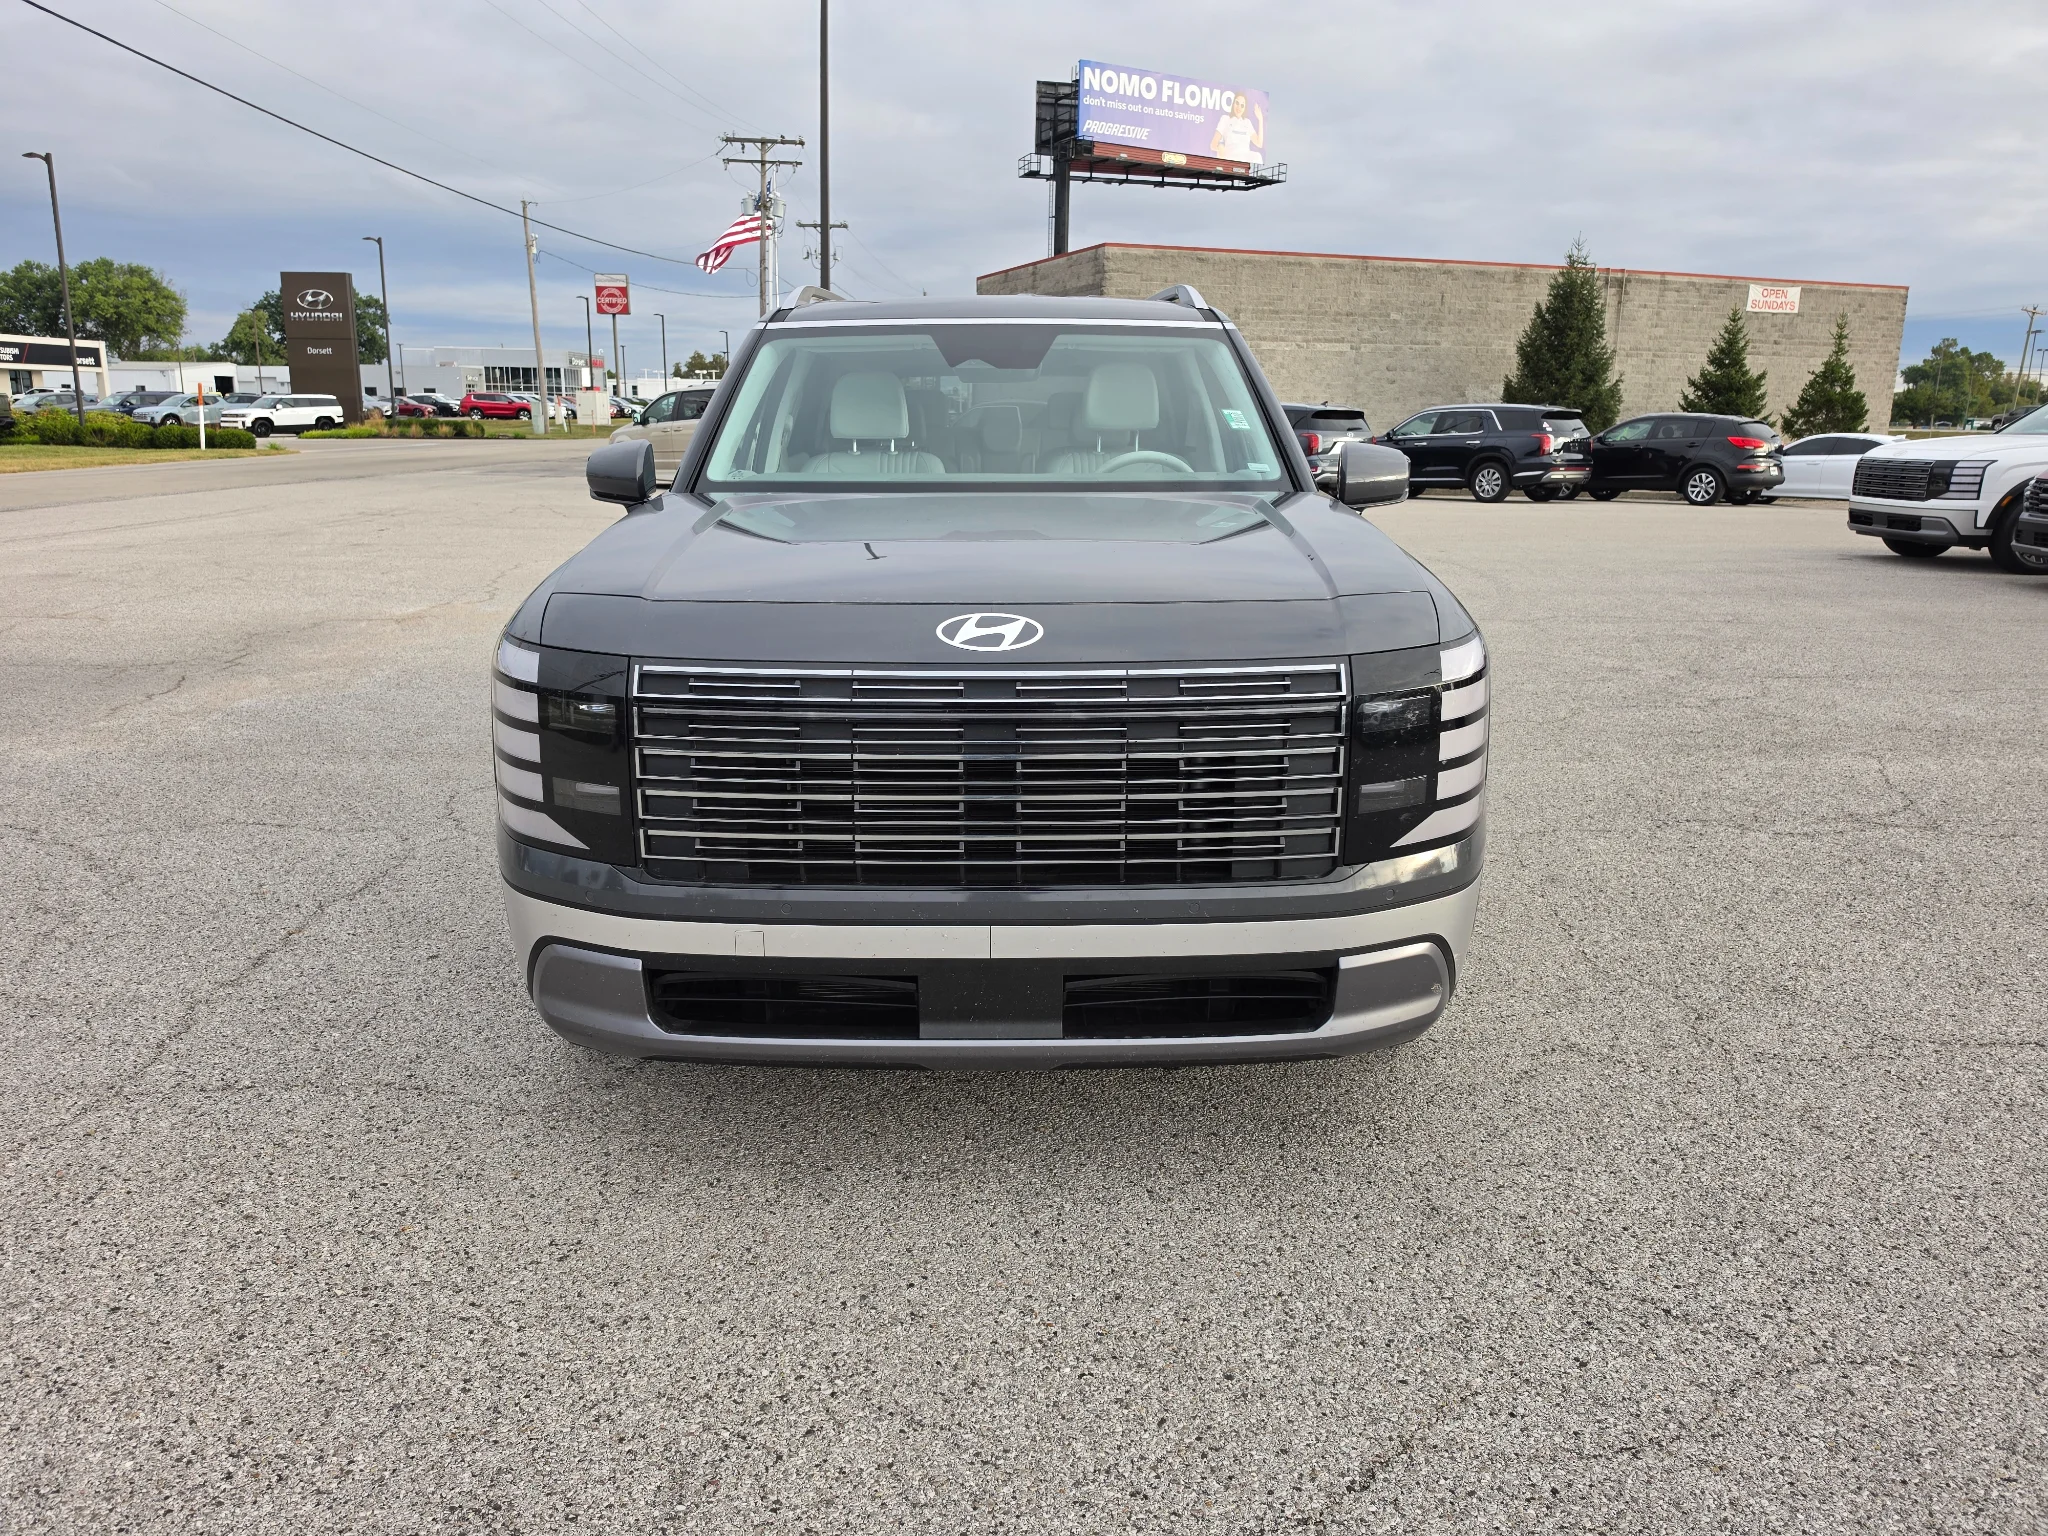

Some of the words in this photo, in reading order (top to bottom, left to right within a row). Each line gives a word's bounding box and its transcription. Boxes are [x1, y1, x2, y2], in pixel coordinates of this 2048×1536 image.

[1083, 66, 1157, 100] NOMO
[1162, 79, 1236, 113] FLOMO
[1083, 95, 1106, 107] don't
[1107, 99, 1127, 110] miss
[1128, 104, 1142, 113] out
[1143, 107, 1154, 115] on
[1155, 107, 1174, 118] auto
[1174, 111, 1205, 124] savings
[1083, 119, 1151, 140] PROGRESSIVE
[1761, 288, 1788, 299] OPEN
[1750, 299, 1796, 311] SUNDAYS
[290, 311, 343, 321] HYUNDAI
[307, 346, 333, 355] Dorsett
[76, 357, 95, 365] orsett
